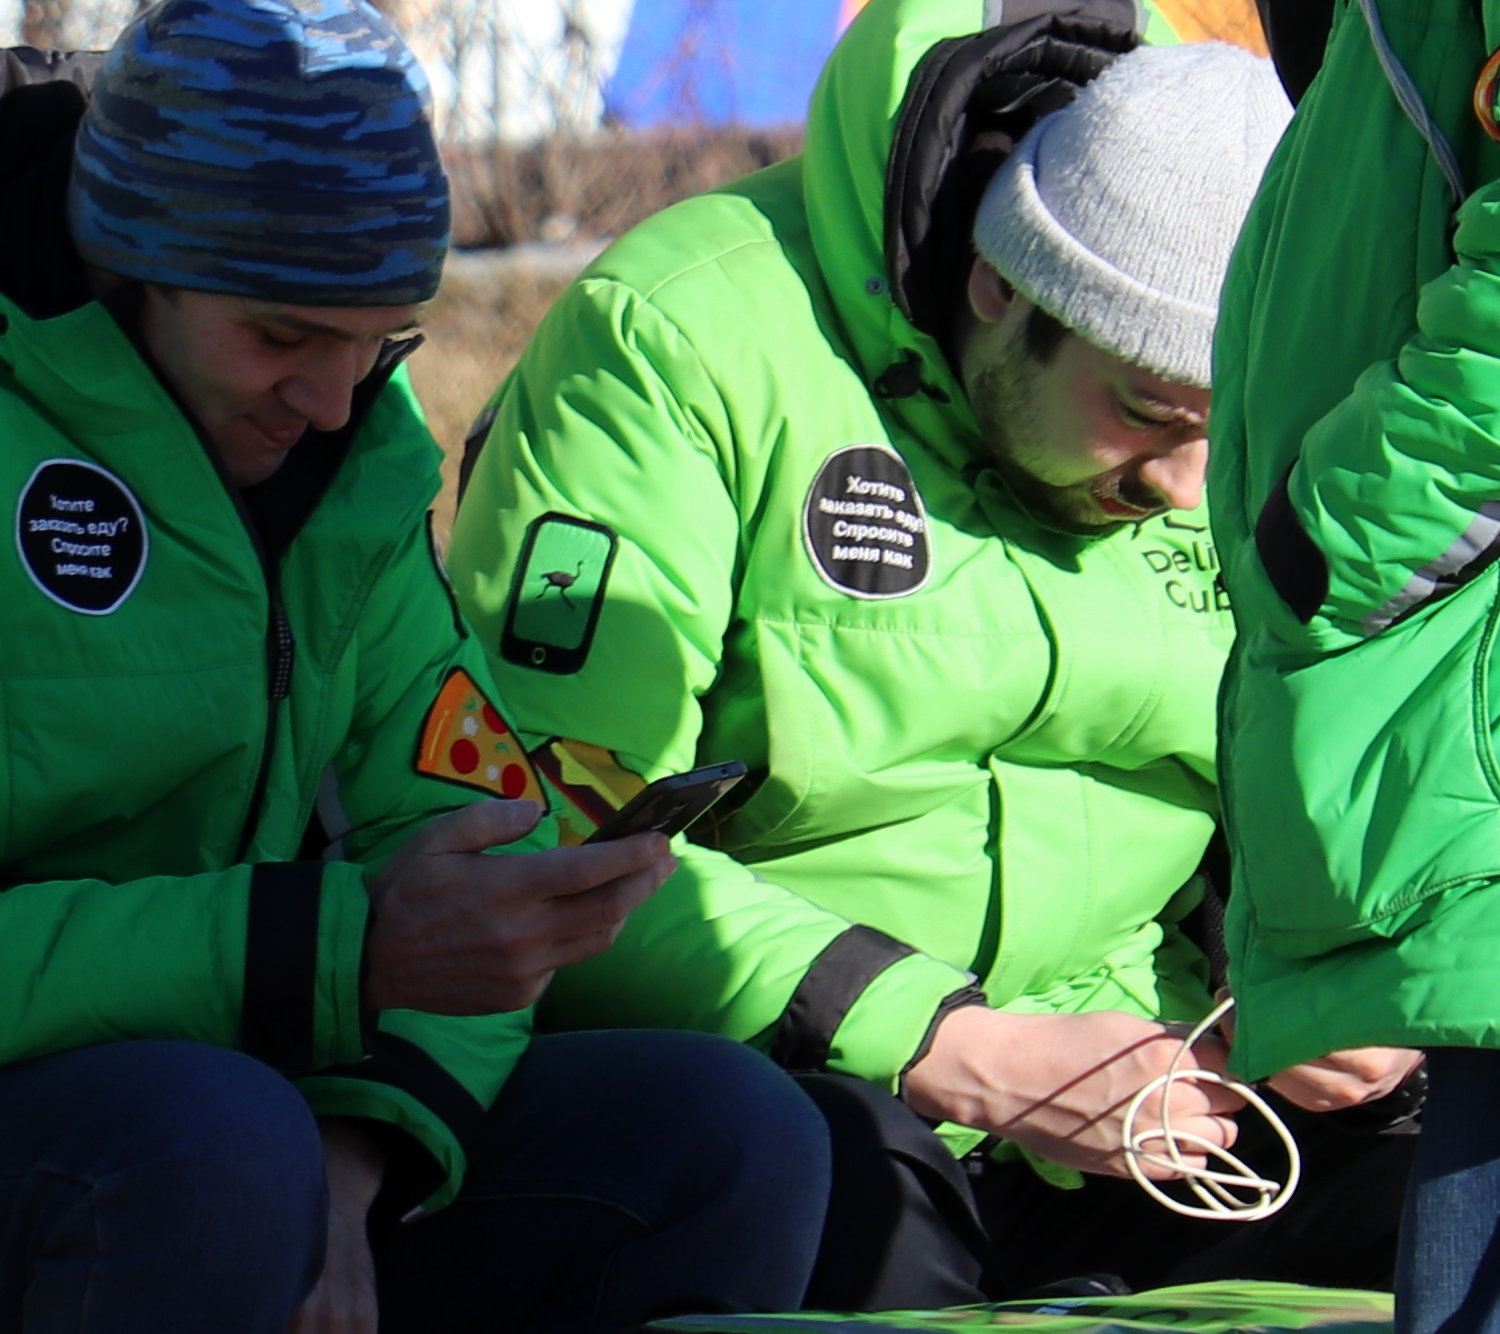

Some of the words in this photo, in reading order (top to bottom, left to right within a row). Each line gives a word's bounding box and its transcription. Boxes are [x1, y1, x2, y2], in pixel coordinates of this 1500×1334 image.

[846, 475, 906, 503] Хотите
[832, 521, 915, 547] Спросите
[832, 544, 880, 561] меня
[882, 550, 914, 570] как
